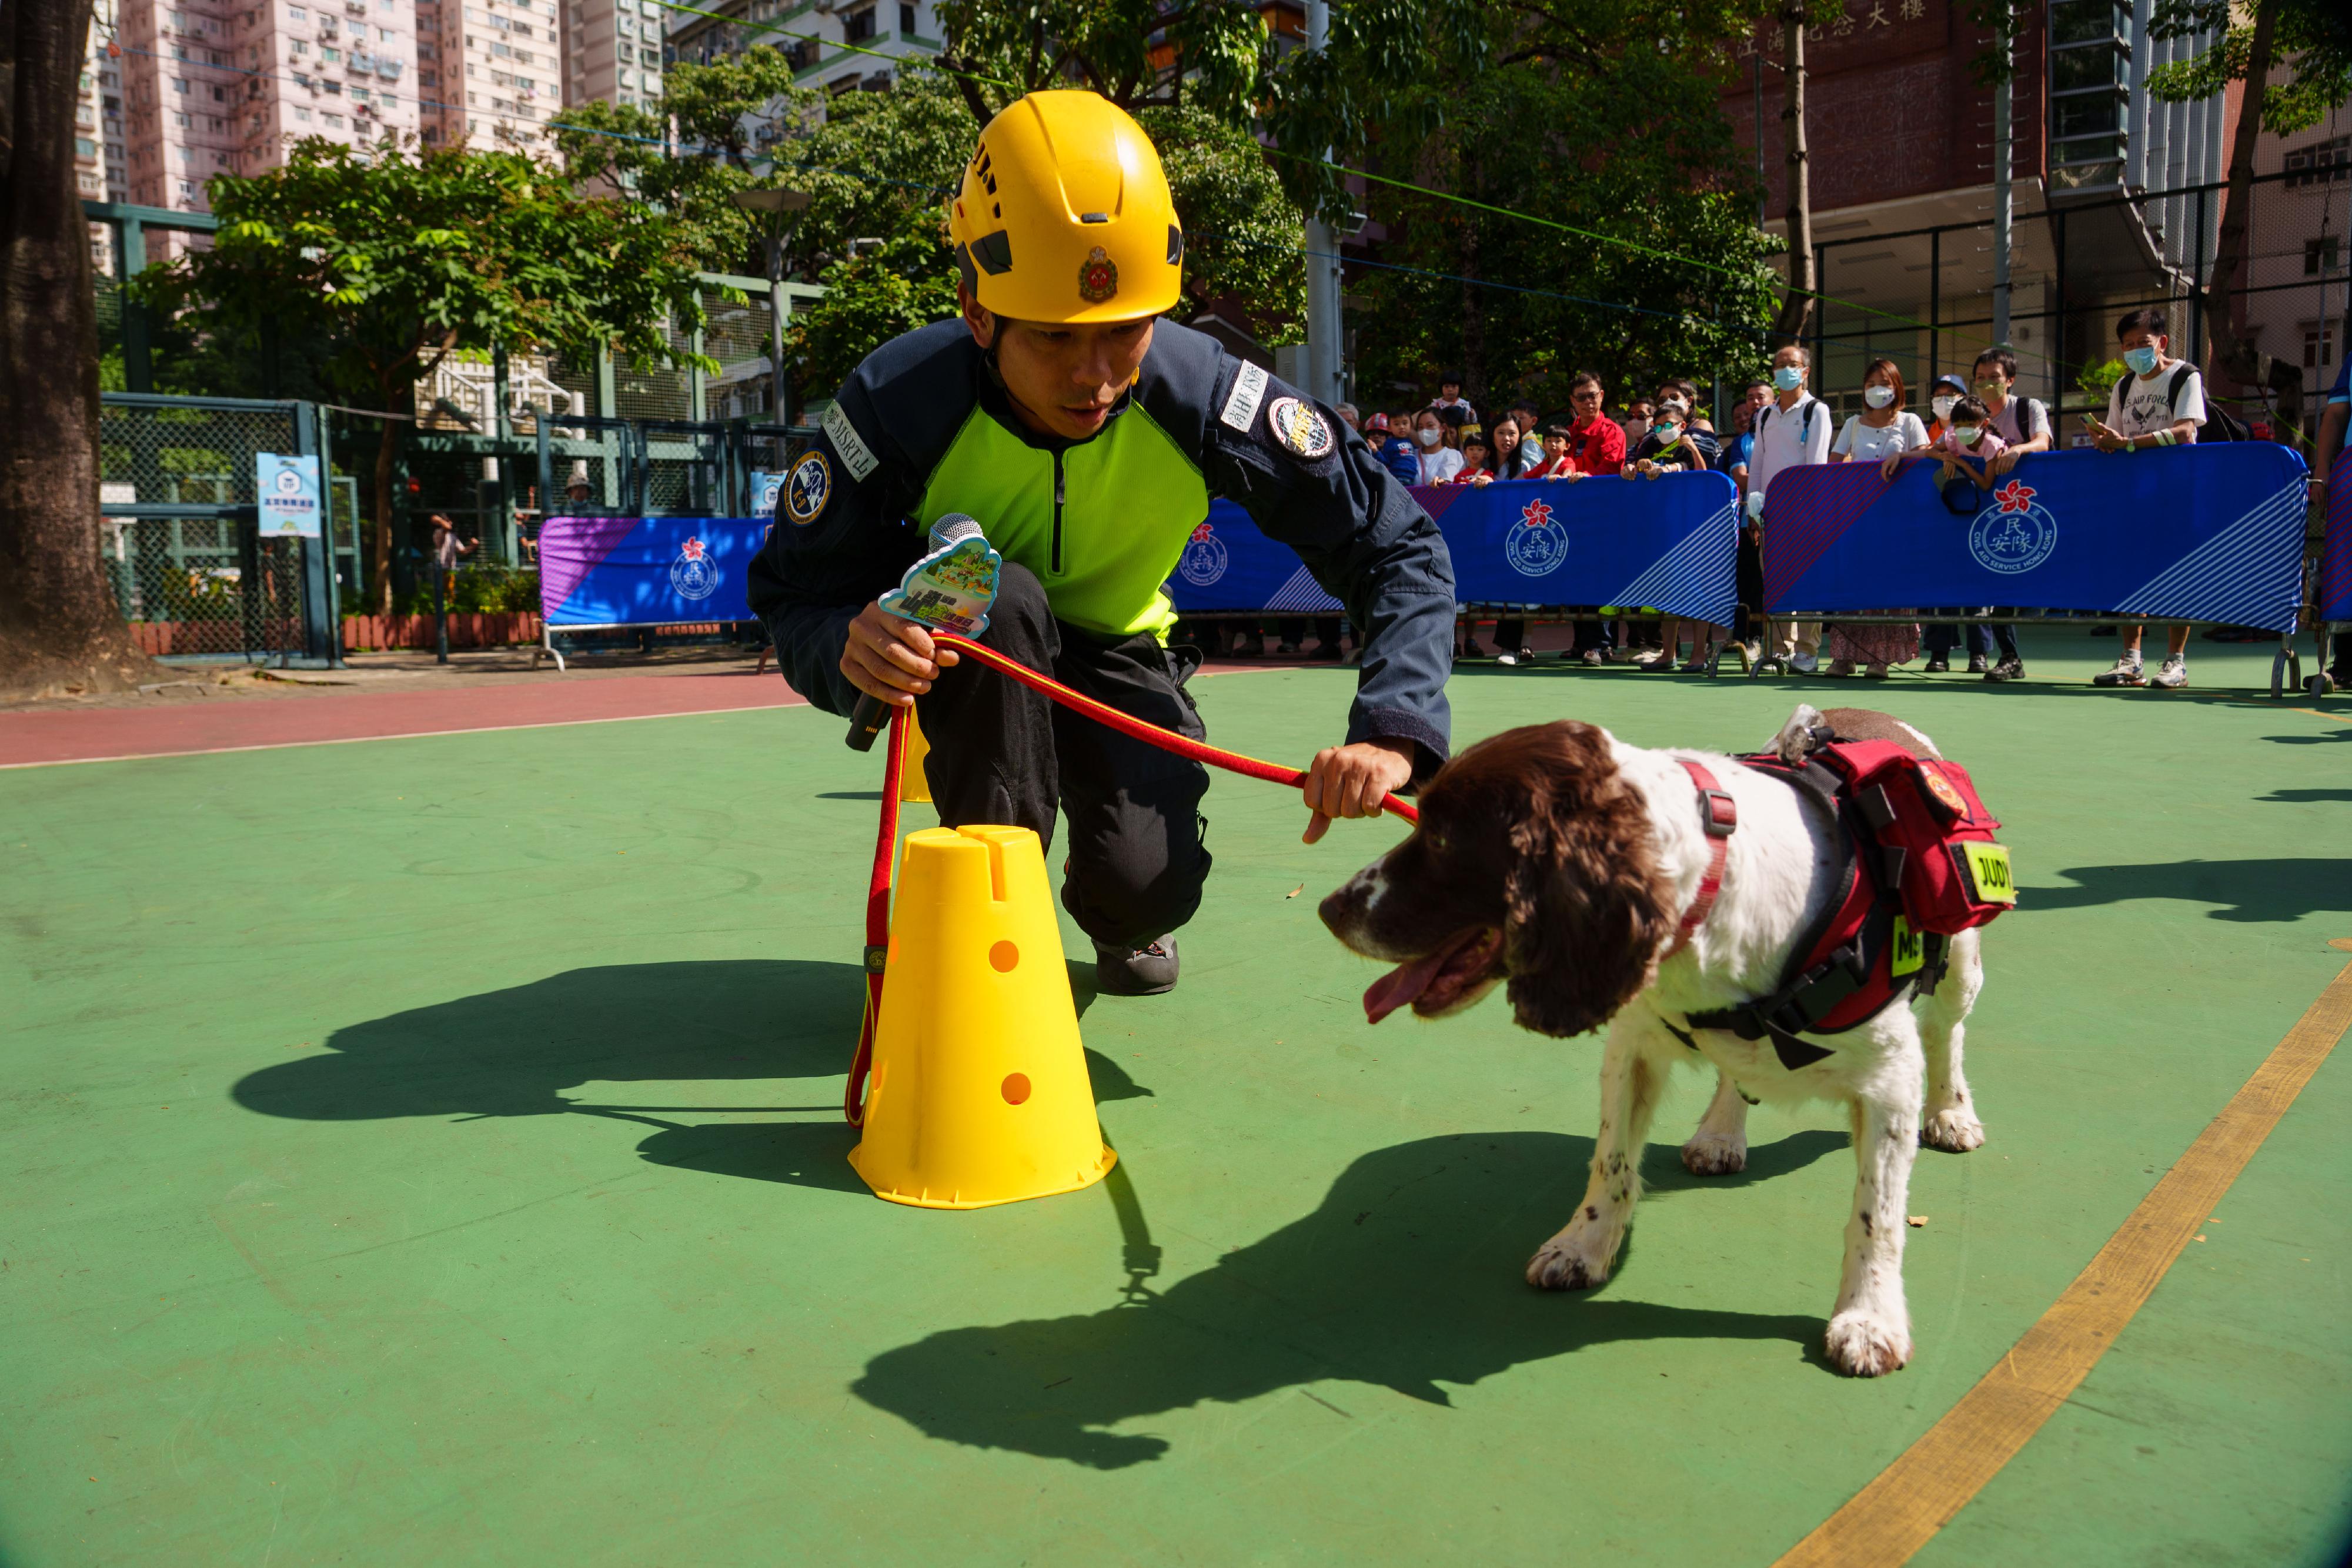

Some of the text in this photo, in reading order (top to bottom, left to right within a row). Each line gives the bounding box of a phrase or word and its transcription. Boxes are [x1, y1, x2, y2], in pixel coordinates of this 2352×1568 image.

[2147, 394, 2169, 406] FORC
[832, 420, 863, 462] MSRT
[793, 487, 807, 509] K-9
[2005, 517, 2025, 535] 民
[1531, 530, 1546, 544] 民
[1989, 533, 2033, 553] 安隊
[1512, 557, 1522, 566] AID
[1521, 565, 1544, 573] SERVICE
[1545, 558, 1560, 571] HONG
[1557, 539, 1565, 558] KONG
[1521, 543, 1551, 559] 安隊
[1978, 550, 1990, 561] AID
[1989, 560, 2022, 570] SERVICE
[2023, 551, 2044, 567] HONG
[2042, 529, 2053, 551] KONG
[1978, 857, 2012, 889] JUDY
